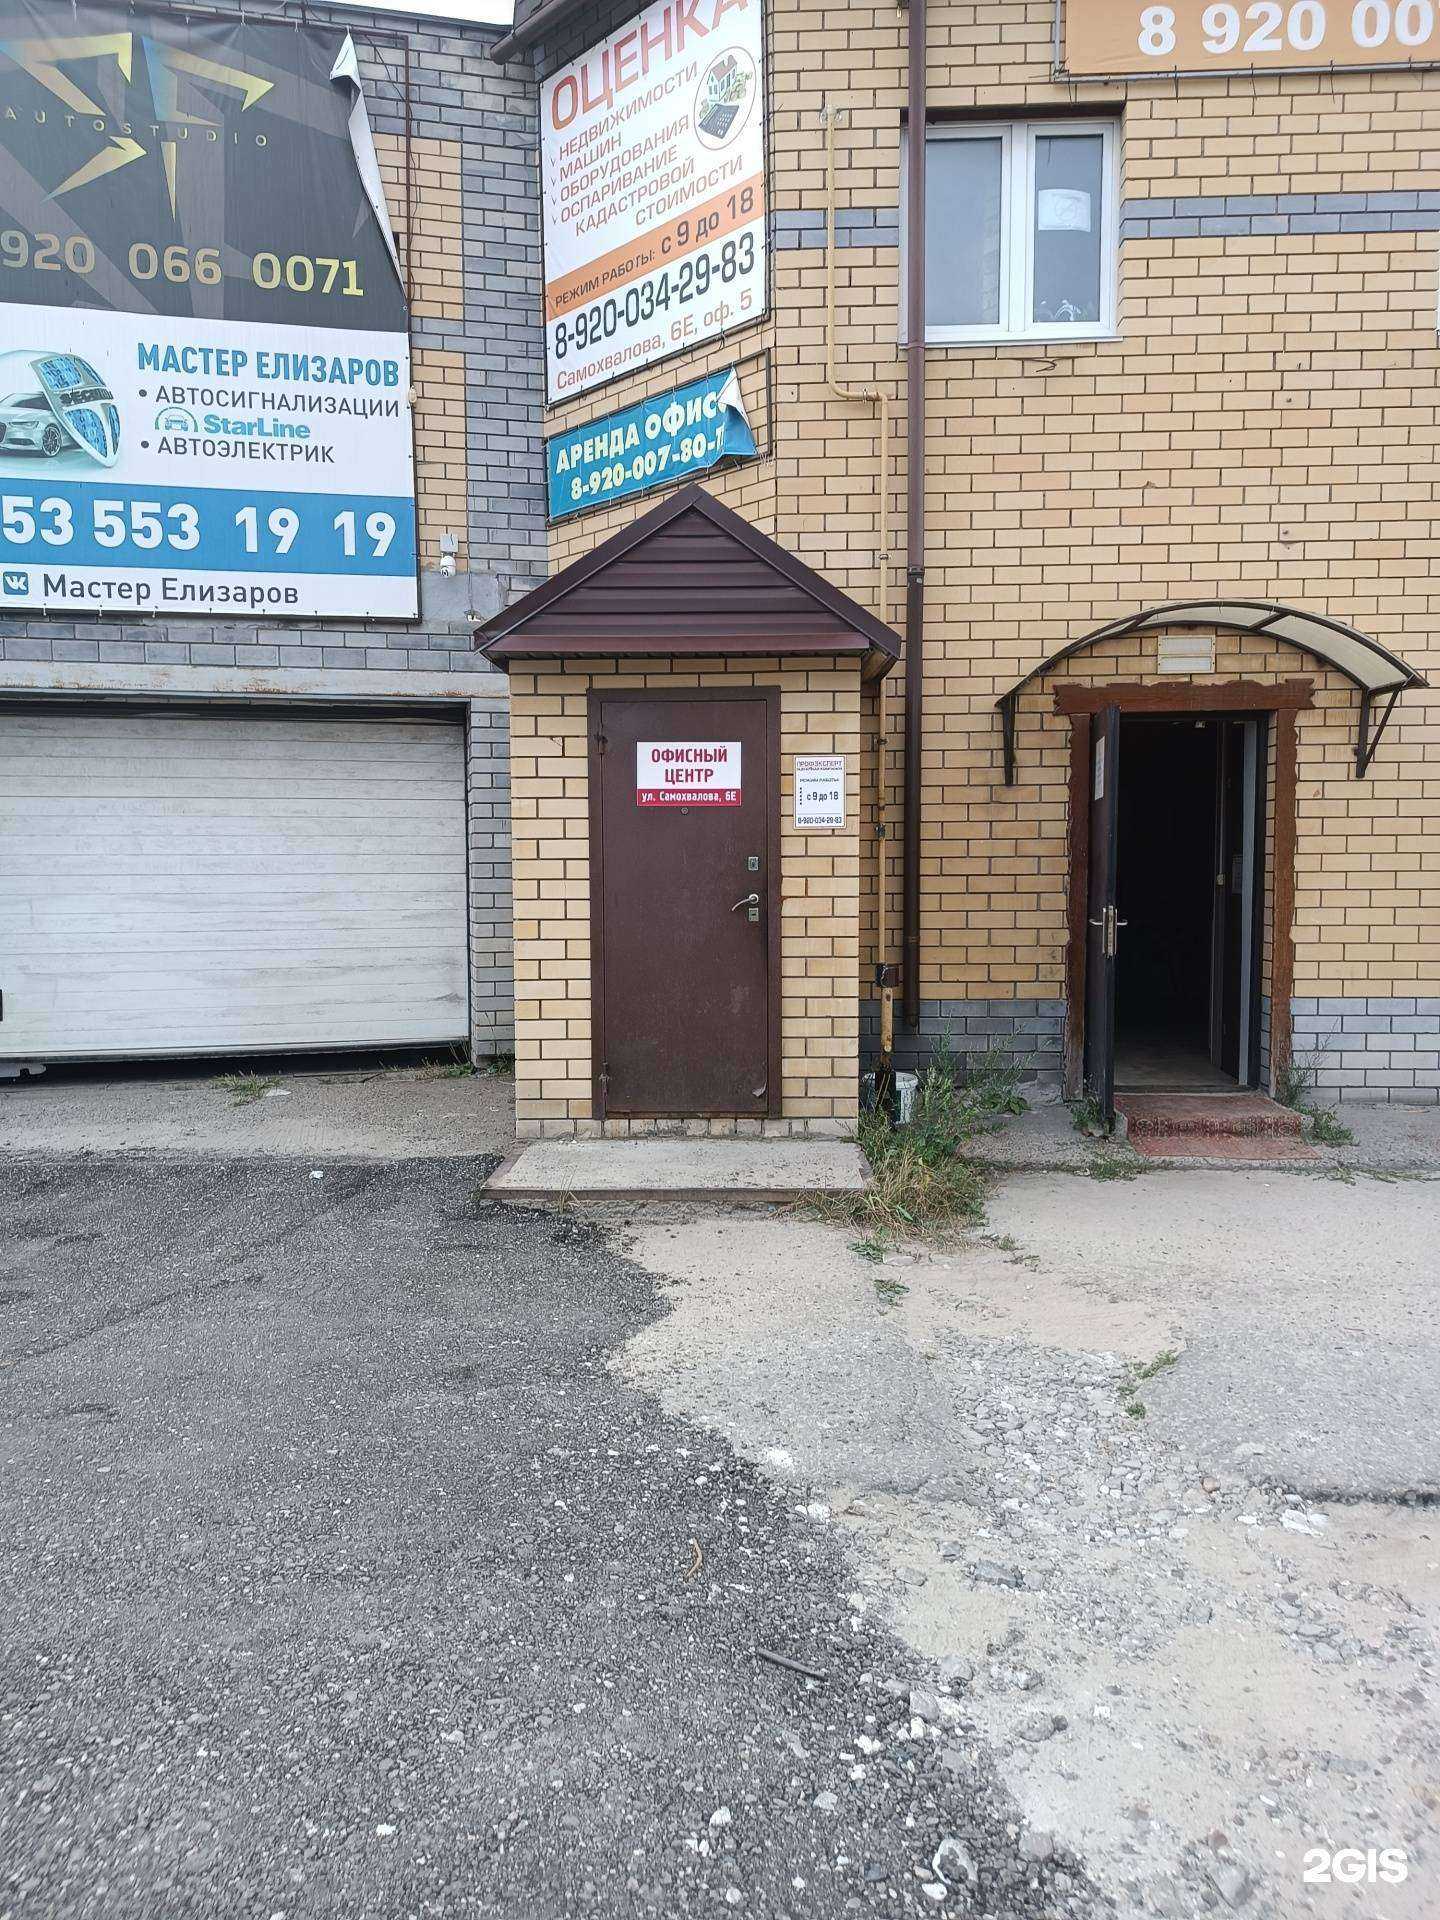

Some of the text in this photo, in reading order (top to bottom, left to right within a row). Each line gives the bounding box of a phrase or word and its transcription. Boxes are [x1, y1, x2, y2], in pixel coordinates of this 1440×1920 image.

[1137, 0, 1434, 56] 8 920 00
[5, 106, 269, 147] AUTOSTUDIO
[559, 61, 698, 160] НЕДВИЖИМОСТИ
[559, 132, 622, 182] МАШИН
[560, 114, 690, 202] ОБОРУДОВАНИЯ
[561, 145, 678, 223] ОСПАРИВАНИЕ
[576, 155, 696, 237] КАДАСТРОВОЙ
[635, 154, 743, 226] СТОИМОСТИ
[0, 230, 364, 297] 920 066 0071
[555, 276, 600, 308] РЕЖИМ
[601, 248, 656, 284] РАБОТЫ:
[676, 221, 690, 246] 9
[696, 212, 720, 238] до
[726, 186, 754, 220] 18
[555, 231, 755, 360] 8-920-034-29-83
[556, 334, 666, 390] Самохвалова,
[703, 300, 734, 333] оф.
[740, 288, 753, 312] 5
[137, 342, 400, 388] МАСТЕР ЕЛИЗАРОВ
[155, 385, 400, 420] АВТОСИГНАЛИЗАЦИИ
[203, 413, 311, 440] StarLine
[157, 437, 335, 464] АВТОЭЛЕКТРИК
[556, 423, 641, 474] АРЕНДА
[1, 494, 398, 559] 53 553 19 19
[43, 573, 300, 609] Мастер Елизаров
[651, 745, 728, 763] ОФИСНЫЙ
[664, 768, 714, 785] ЦЕНТР
[641, 791, 656, 802] ул.
[659, 790, 722, 803] Самохвалова,
[812, 791, 818, 801] 9
[818, 793, 828, 803] до
[829, 791, 839, 801] 18
